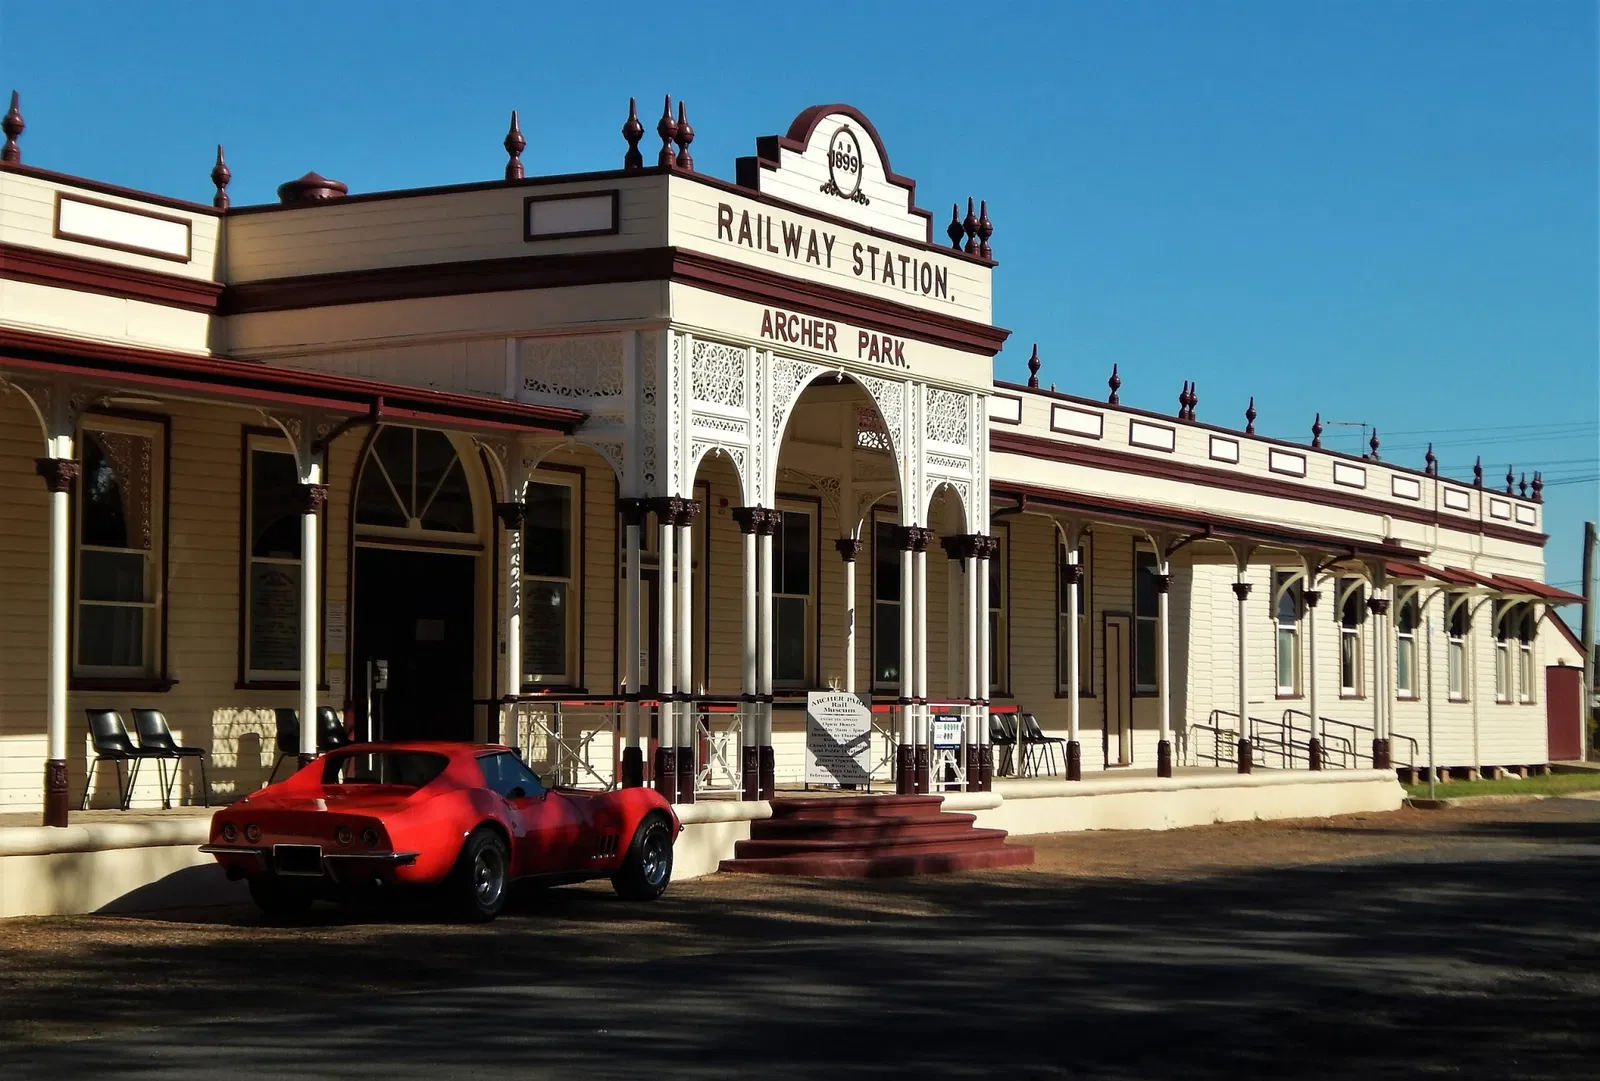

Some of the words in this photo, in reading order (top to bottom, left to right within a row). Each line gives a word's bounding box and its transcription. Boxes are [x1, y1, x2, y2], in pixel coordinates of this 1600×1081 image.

[832, 150, 858, 174] 1899
[718, 202, 836, 268] RAILWAY
[852, 242, 955, 302] STATION.
[760, 309, 838, 353] ARCHER
[858, 330, 910, 370] PARK.
[811, 696, 844, 706] ARCHER
